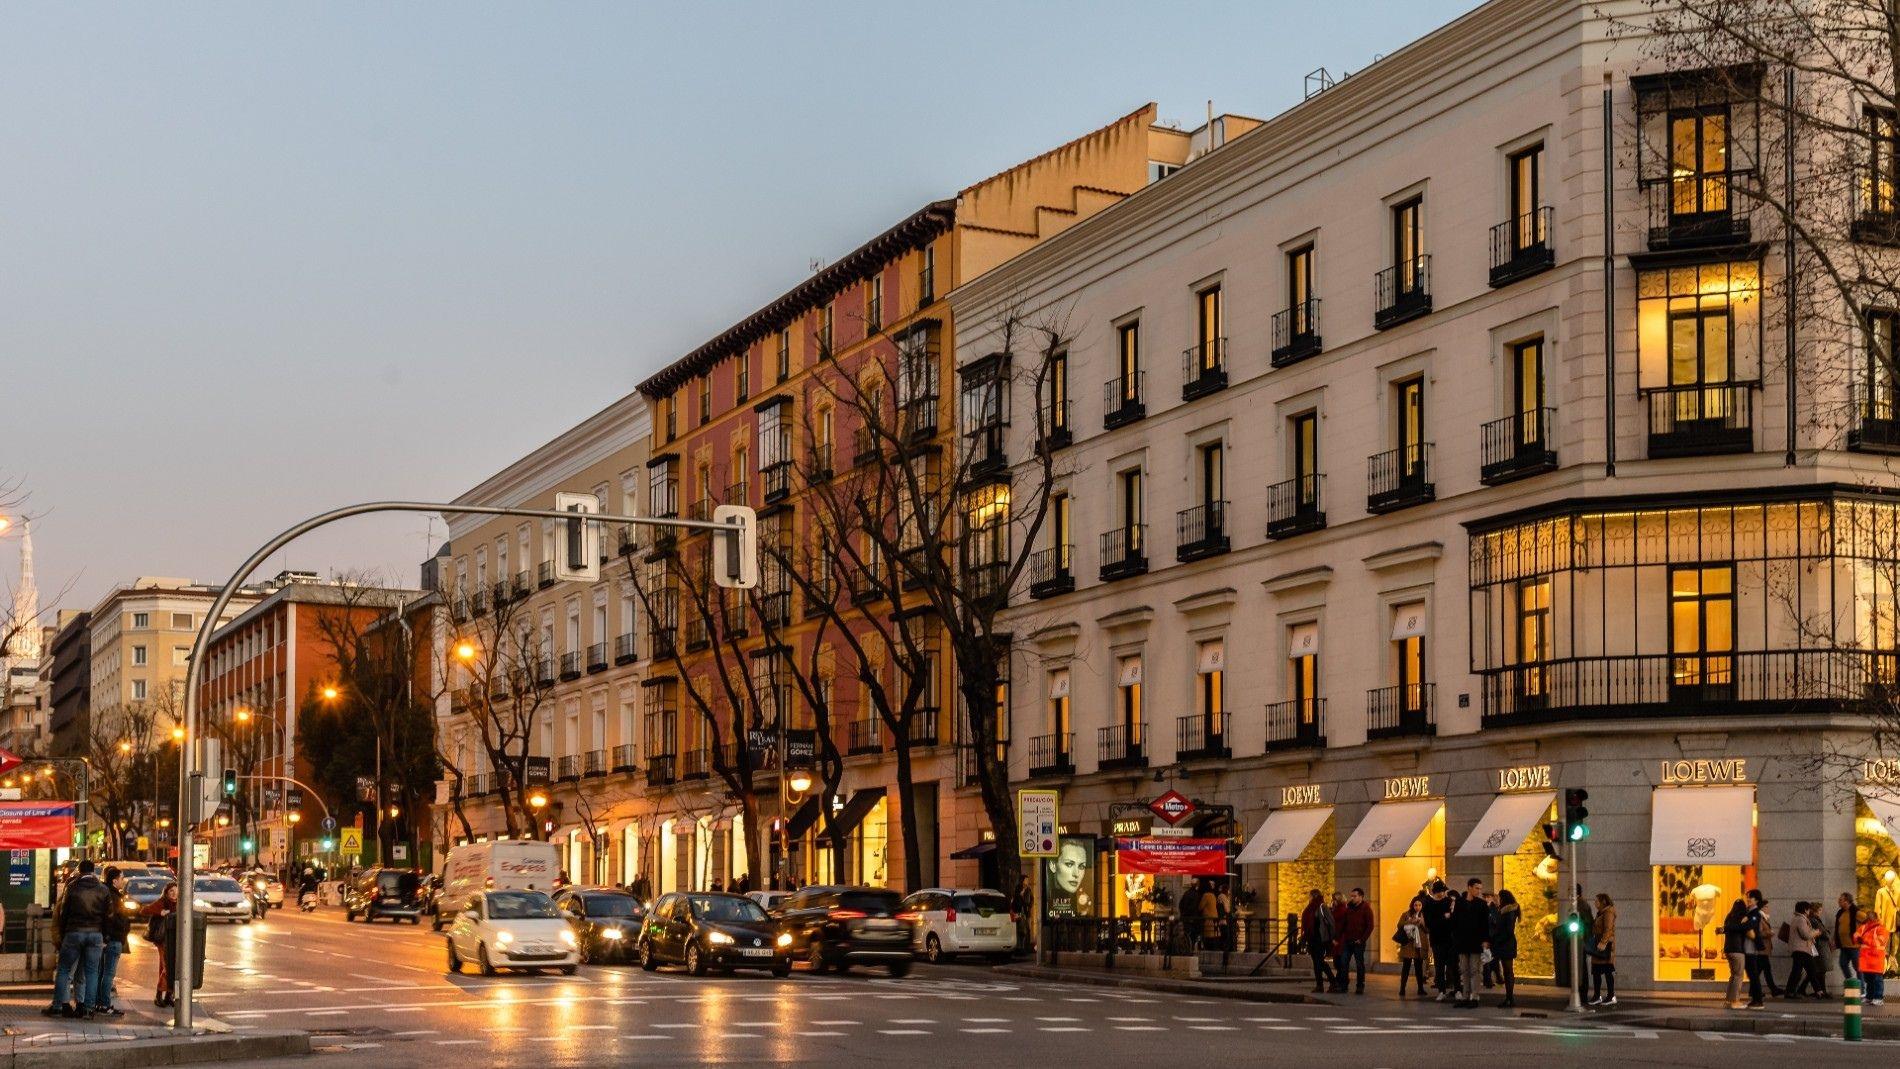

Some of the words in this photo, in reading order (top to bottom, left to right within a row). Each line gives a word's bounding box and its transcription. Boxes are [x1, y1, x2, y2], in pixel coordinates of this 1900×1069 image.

[1499, 765, 1551, 790] LOEWE
[1662, 760, 1746, 782] LOEWE
[1864, 759, 1900, 782] LOE
[1282, 785, 1320, 806] LOEWE
[1385, 777, 1429, 799] LOEWE
[1165, 803, 1185, 811] Metro
[1114, 821, 1140, 833] PRADA
